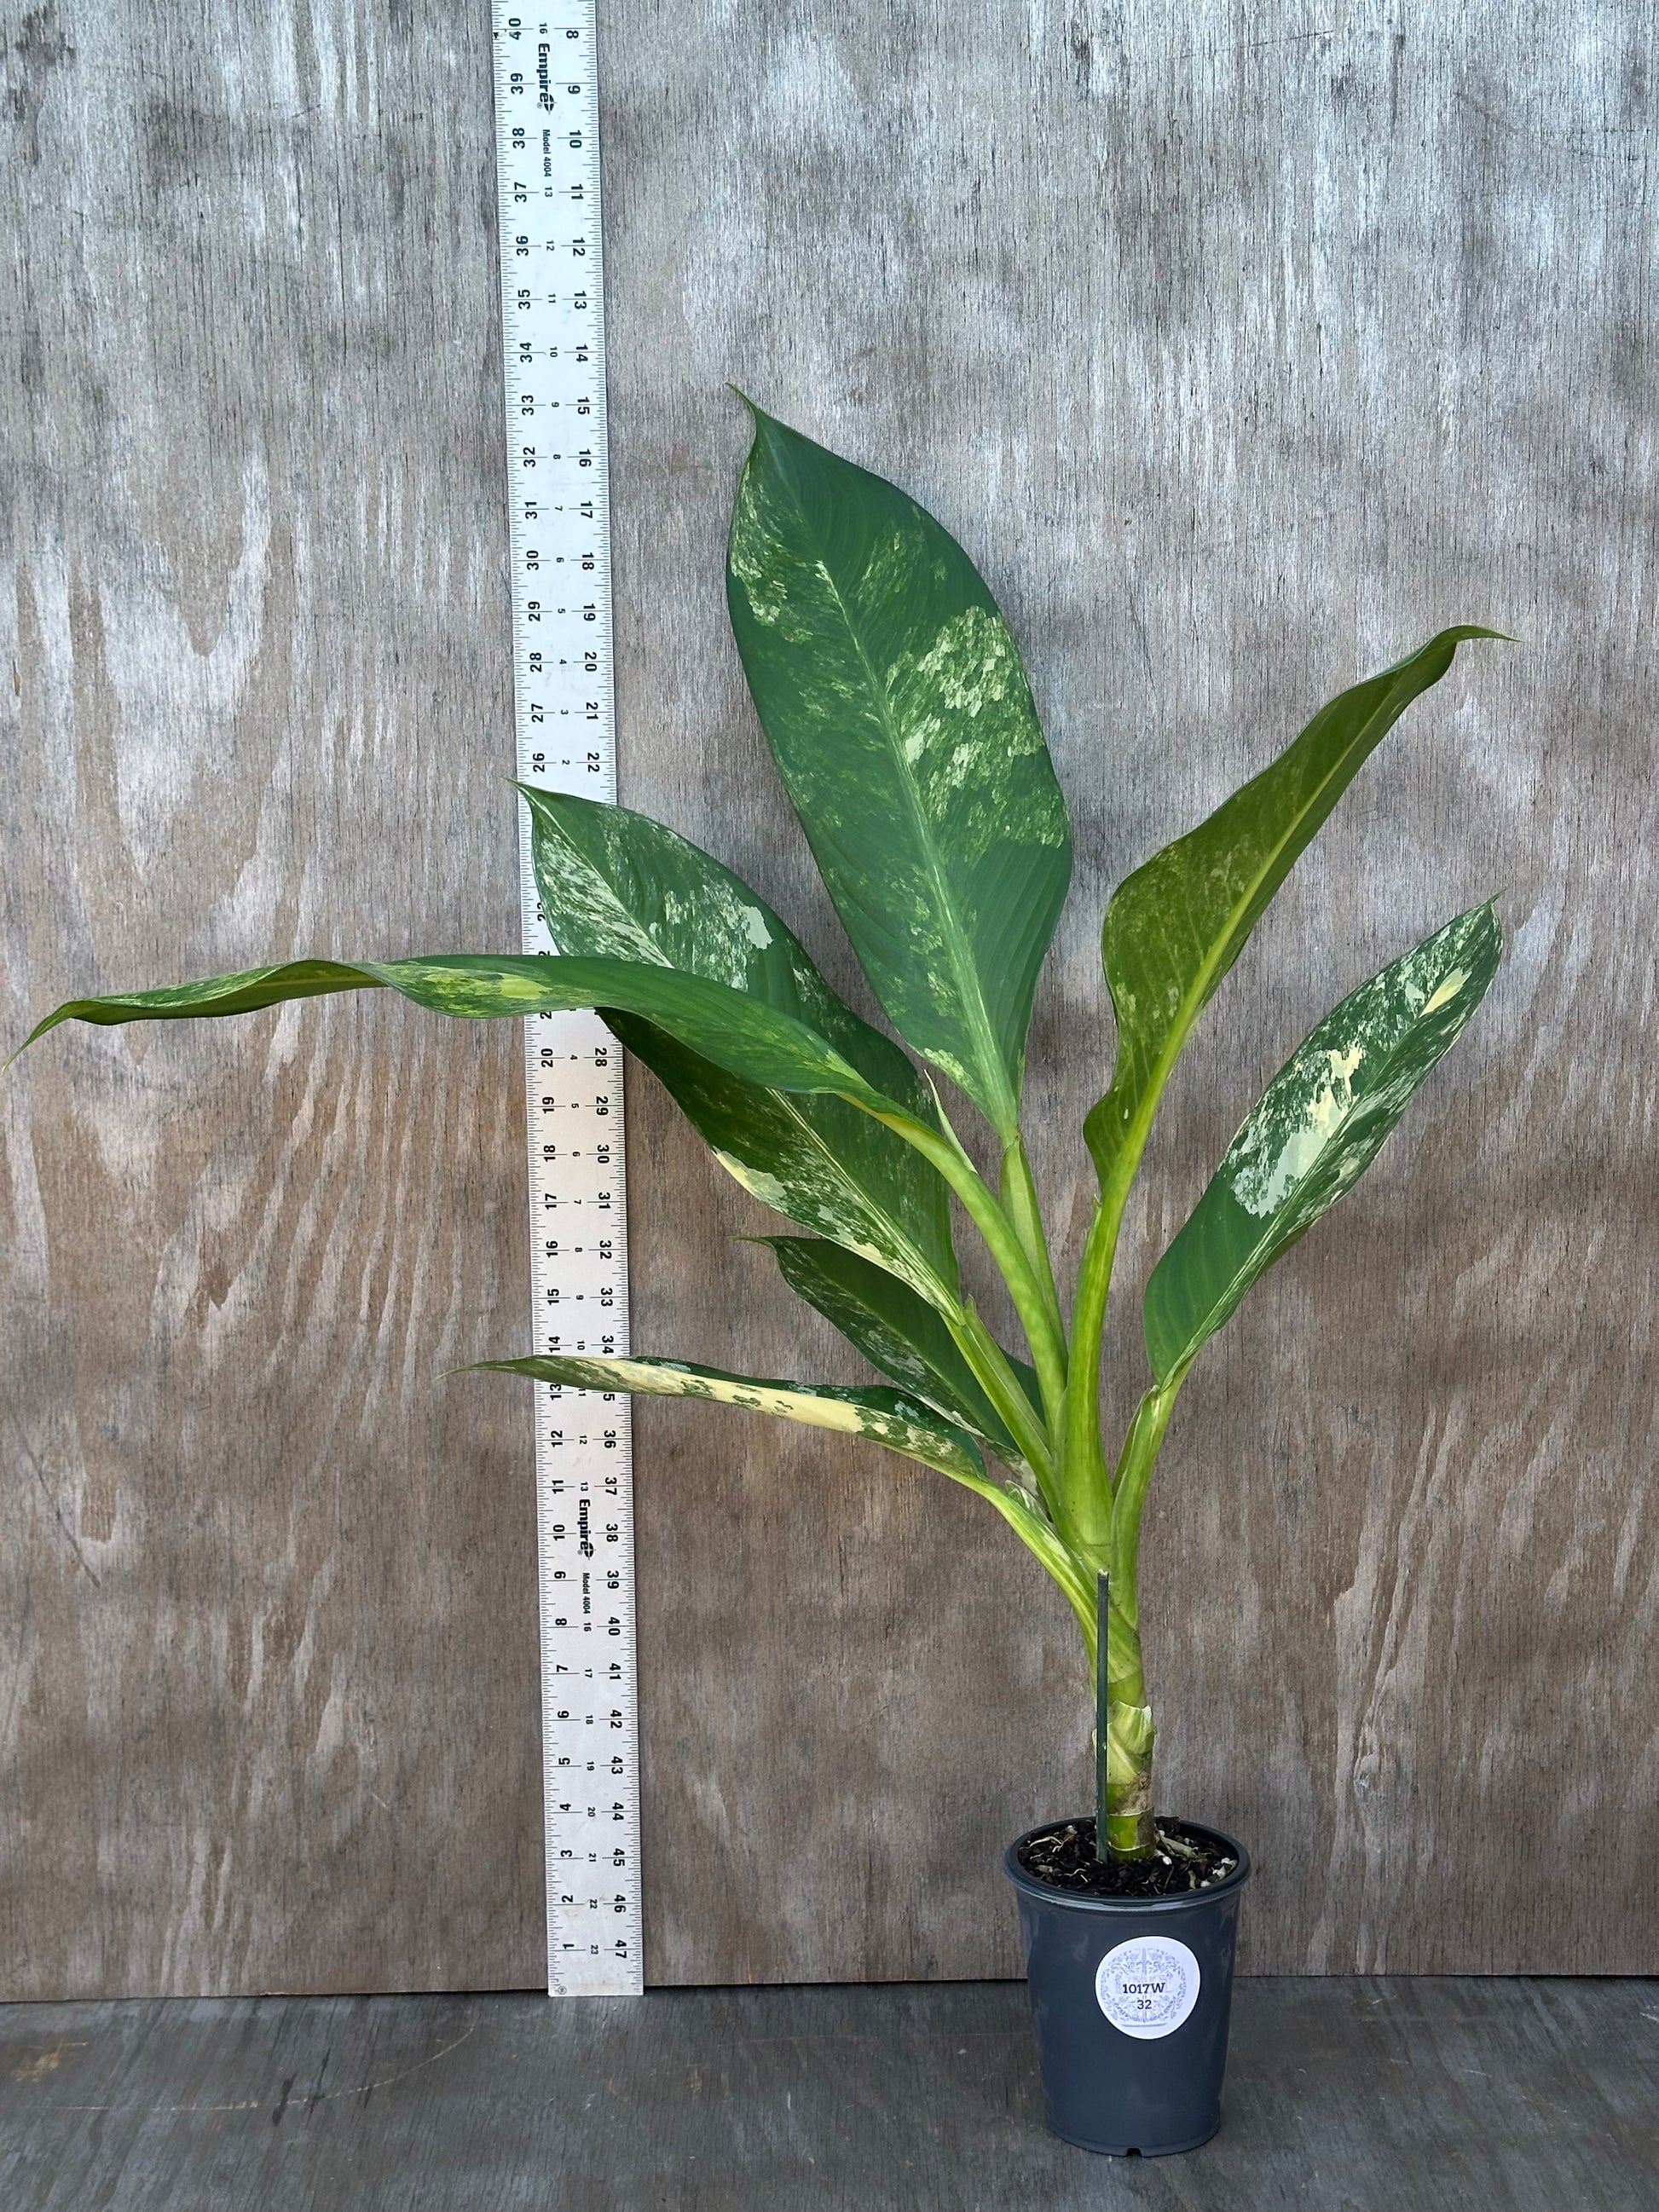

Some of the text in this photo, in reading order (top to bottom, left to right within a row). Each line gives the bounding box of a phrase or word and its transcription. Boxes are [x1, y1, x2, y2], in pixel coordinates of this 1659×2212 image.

[509, 18, 521, 40] 40
[540, 23, 547, 34] 16
[566, 30, 579, 39] 8
[536, 43, 552, 102] Empire
[511, 72, 523, 95] 39
[568, 85, 581, 95] 9
[512, 128, 525, 149] 38
[569, 130, 581, 148] 10
[543, 157, 552, 176] 4004
[514, 182, 527, 203] 37
[545, 186, 552, 197] 13
[571, 184, 583, 199] 11
[516, 236, 529, 256] 36
[546, 240, 554, 251] 12
[572, 238, 585, 257] 12
[517, 290, 530, 309] 35
[548, 294, 556, 303] 11
[574, 291, 587, 309] 13
[520, 343, 532, 362] 34
[550, 347, 558, 357] 10
[575, 344, 588, 362] 14
[522, 395, 534, 415] 33
[577, 397, 590, 414] 15
[523, 447, 535, 467] 32
[579, 449, 592, 467] 16
[524, 502, 537, 519] 31
[581, 501, 592, 518] 17
[526, 551, 539, 570] 30
[582, 552, 594, 570] 18
[528, 601, 540, 621] 29
[583, 604, 596, 621] 19
[530, 653, 542, 673] 28
[585, 652, 597, 672] 20
[531, 703, 543, 723] 27
[586, 702, 598, 719] 21
[533, 754, 545, 772] 26
[587, 753, 599, 772] 22
[541, 1048, 553, 1068] 20
[595, 1048, 607, 1067] 28
[542, 1097, 554, 1113] 19
[596, 1096, 609, 1116] 29
[544, 1145, 556, 1162] 18
[597, 1145, 610, 1164] 30
[545, 1193, 557, 1210] 17
[598, 1193, 611, 1209] 31
[546, 1240, 558, 1257] 16
[599, 1240, 612, 1259] 32
[547, 1289, 559, 1305] 15
[601, 1288, 613, 1307] 33
[549, 1336, 560, 1353] 14
[577, 1341, 585, 1350] 10
[602, 1335, 614, 1354] 34
[550, 1383, 562, 1401] 13
[551, 1430, 563, 1447] 12
[580, 1435, 587, 1444] 12
[604, 1430, 616, 1448] 36
[552, 1480, 564, 1493] 11
[581, 1481, 588, 1491] 13
[605, 1477, 617, 1495] 37
[553, 1524, 565, 1540] 10
[577, 1499, 590, 1551] Empire
[606, 1523, 618, 1542] 38
[607, 1570, 620, 1589] 39
[582, 1596, 591, 1614] 4004
[583, 1622, 592, 1632] 16
[608, 1617, 620, 1636] 40
[585, 1669, 592, 1678] 17
[610, 1663, 621, 1680] 41
[586, 1715, 593, 1724] 18
[610, 1710, 622, 1729] 42
[587, 1761, 594, 1770] 19
[611, 1756, 623, 1775] 43
[587, 1807, 596, 1816] 20
[612, 1802, 624, 1821] 44
[589, 1853, 597, 1862] 21
[613, 1848, 625, 1866] 45
[590, 1899, 598, 1909] 22
[614, 1894, 626, 1913] 46
[615, 1940, 627, 1958] 47
[1123, 1983, 1165, 1994] 1017W
[1137, 2000, 1152, 2009] 32
